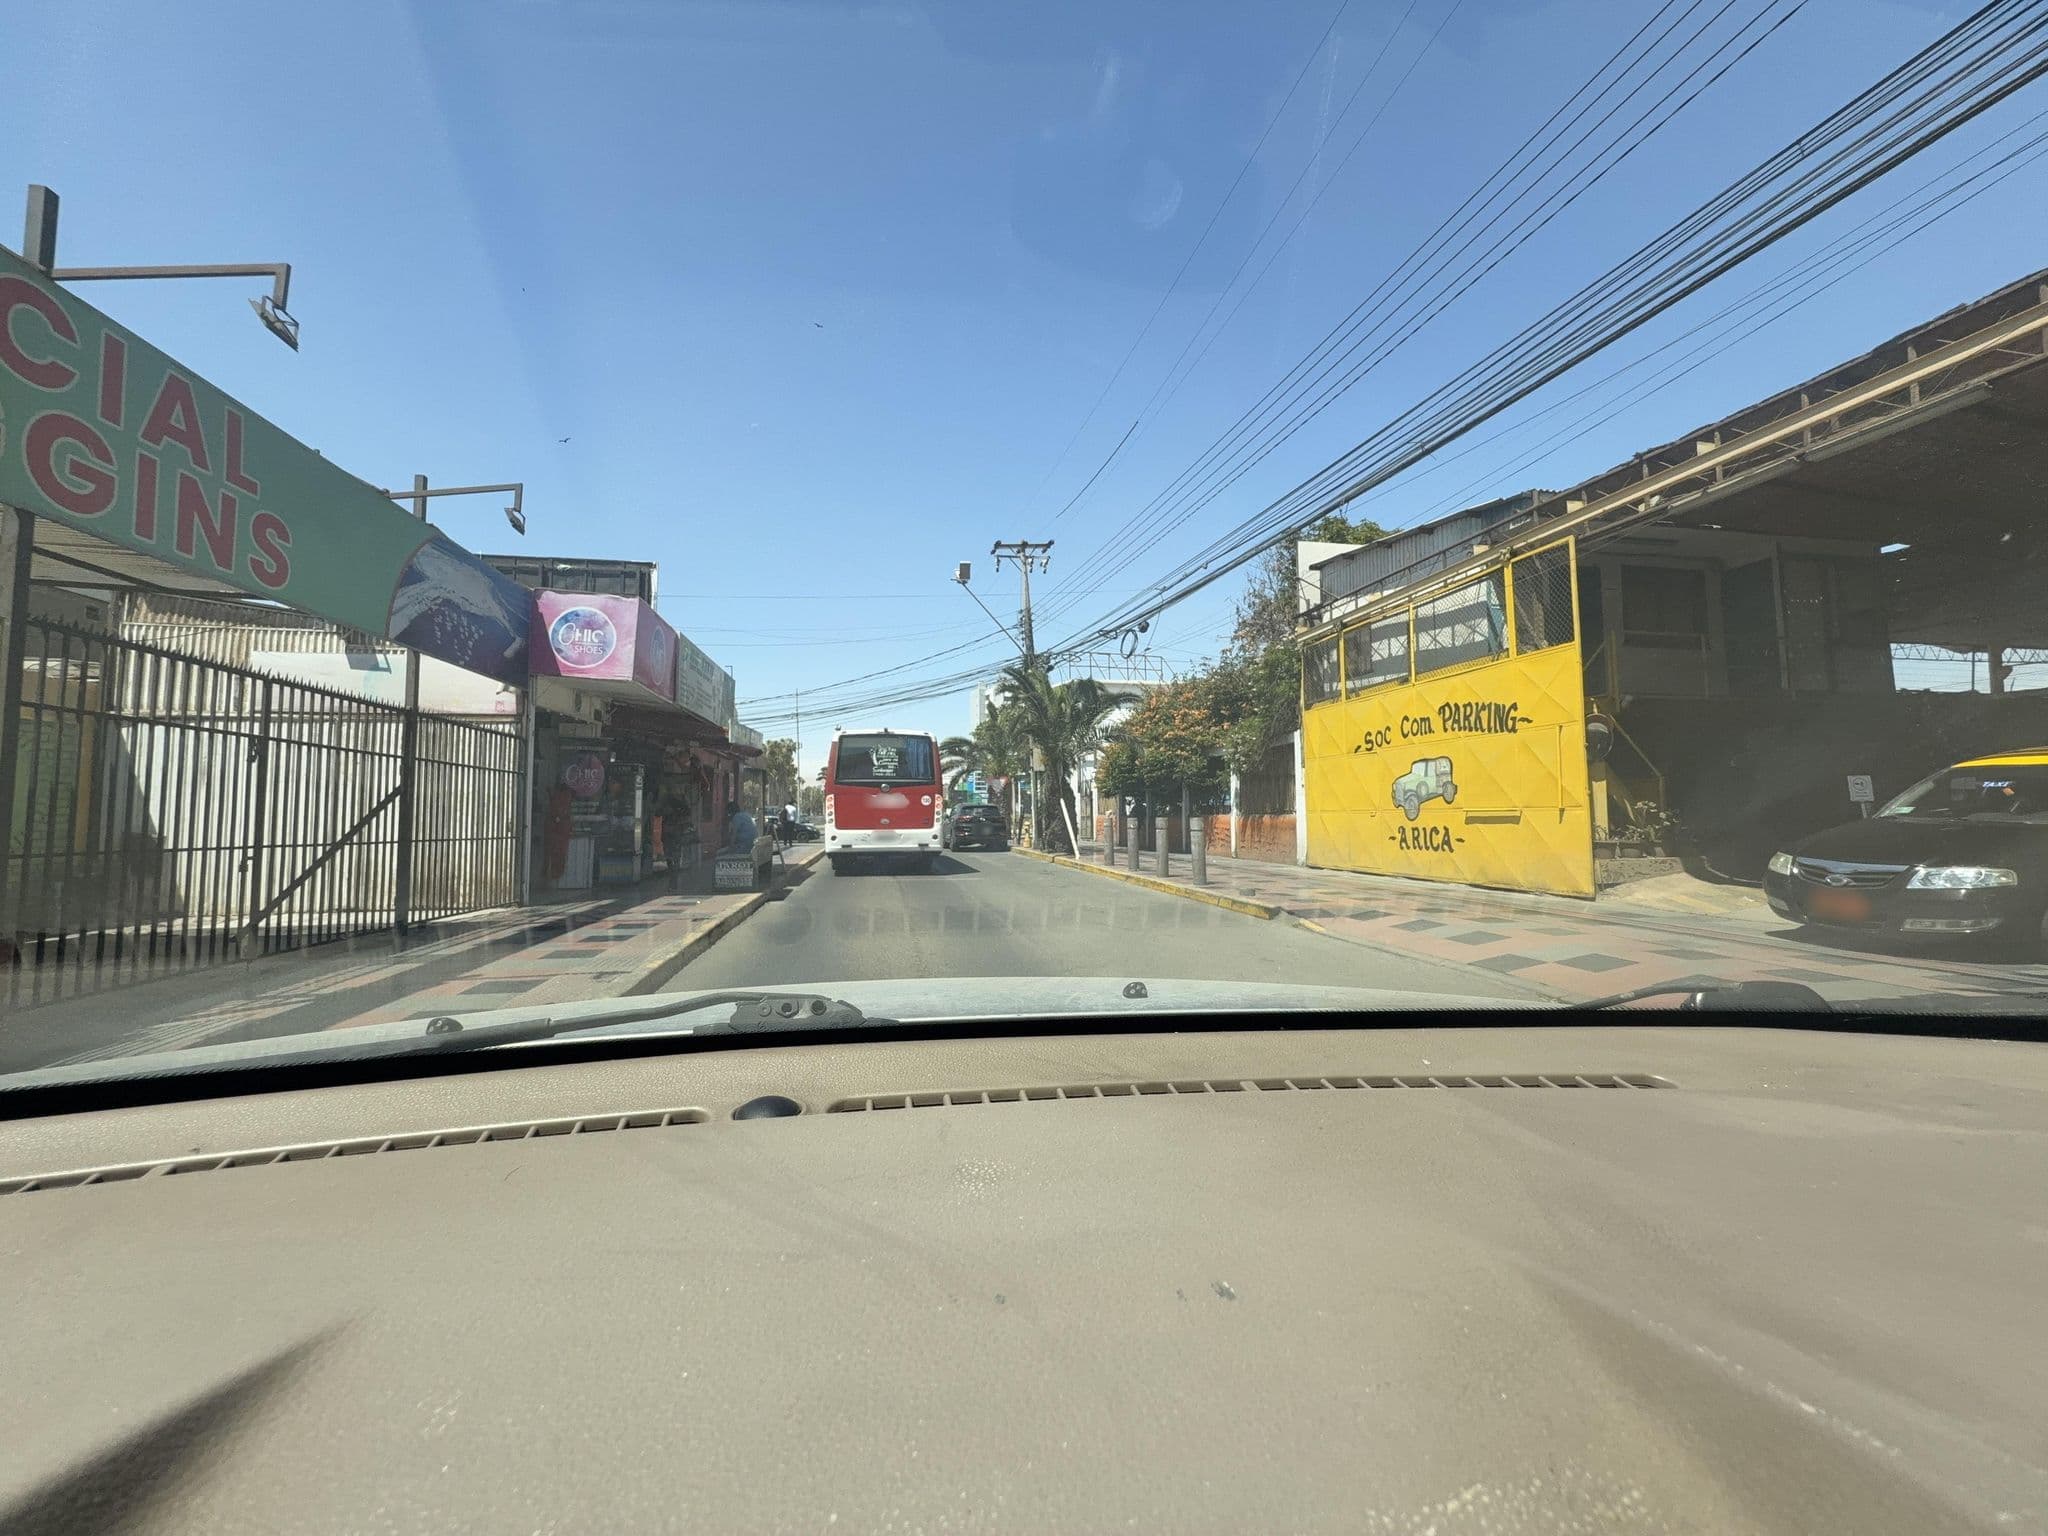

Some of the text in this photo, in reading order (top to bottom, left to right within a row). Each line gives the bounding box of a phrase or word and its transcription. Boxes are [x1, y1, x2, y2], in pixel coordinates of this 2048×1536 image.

[0, 403, 292, 590] GINS
[558, 622, 604, 645] CHIC
[574, 646, 604, 655] SHOES
